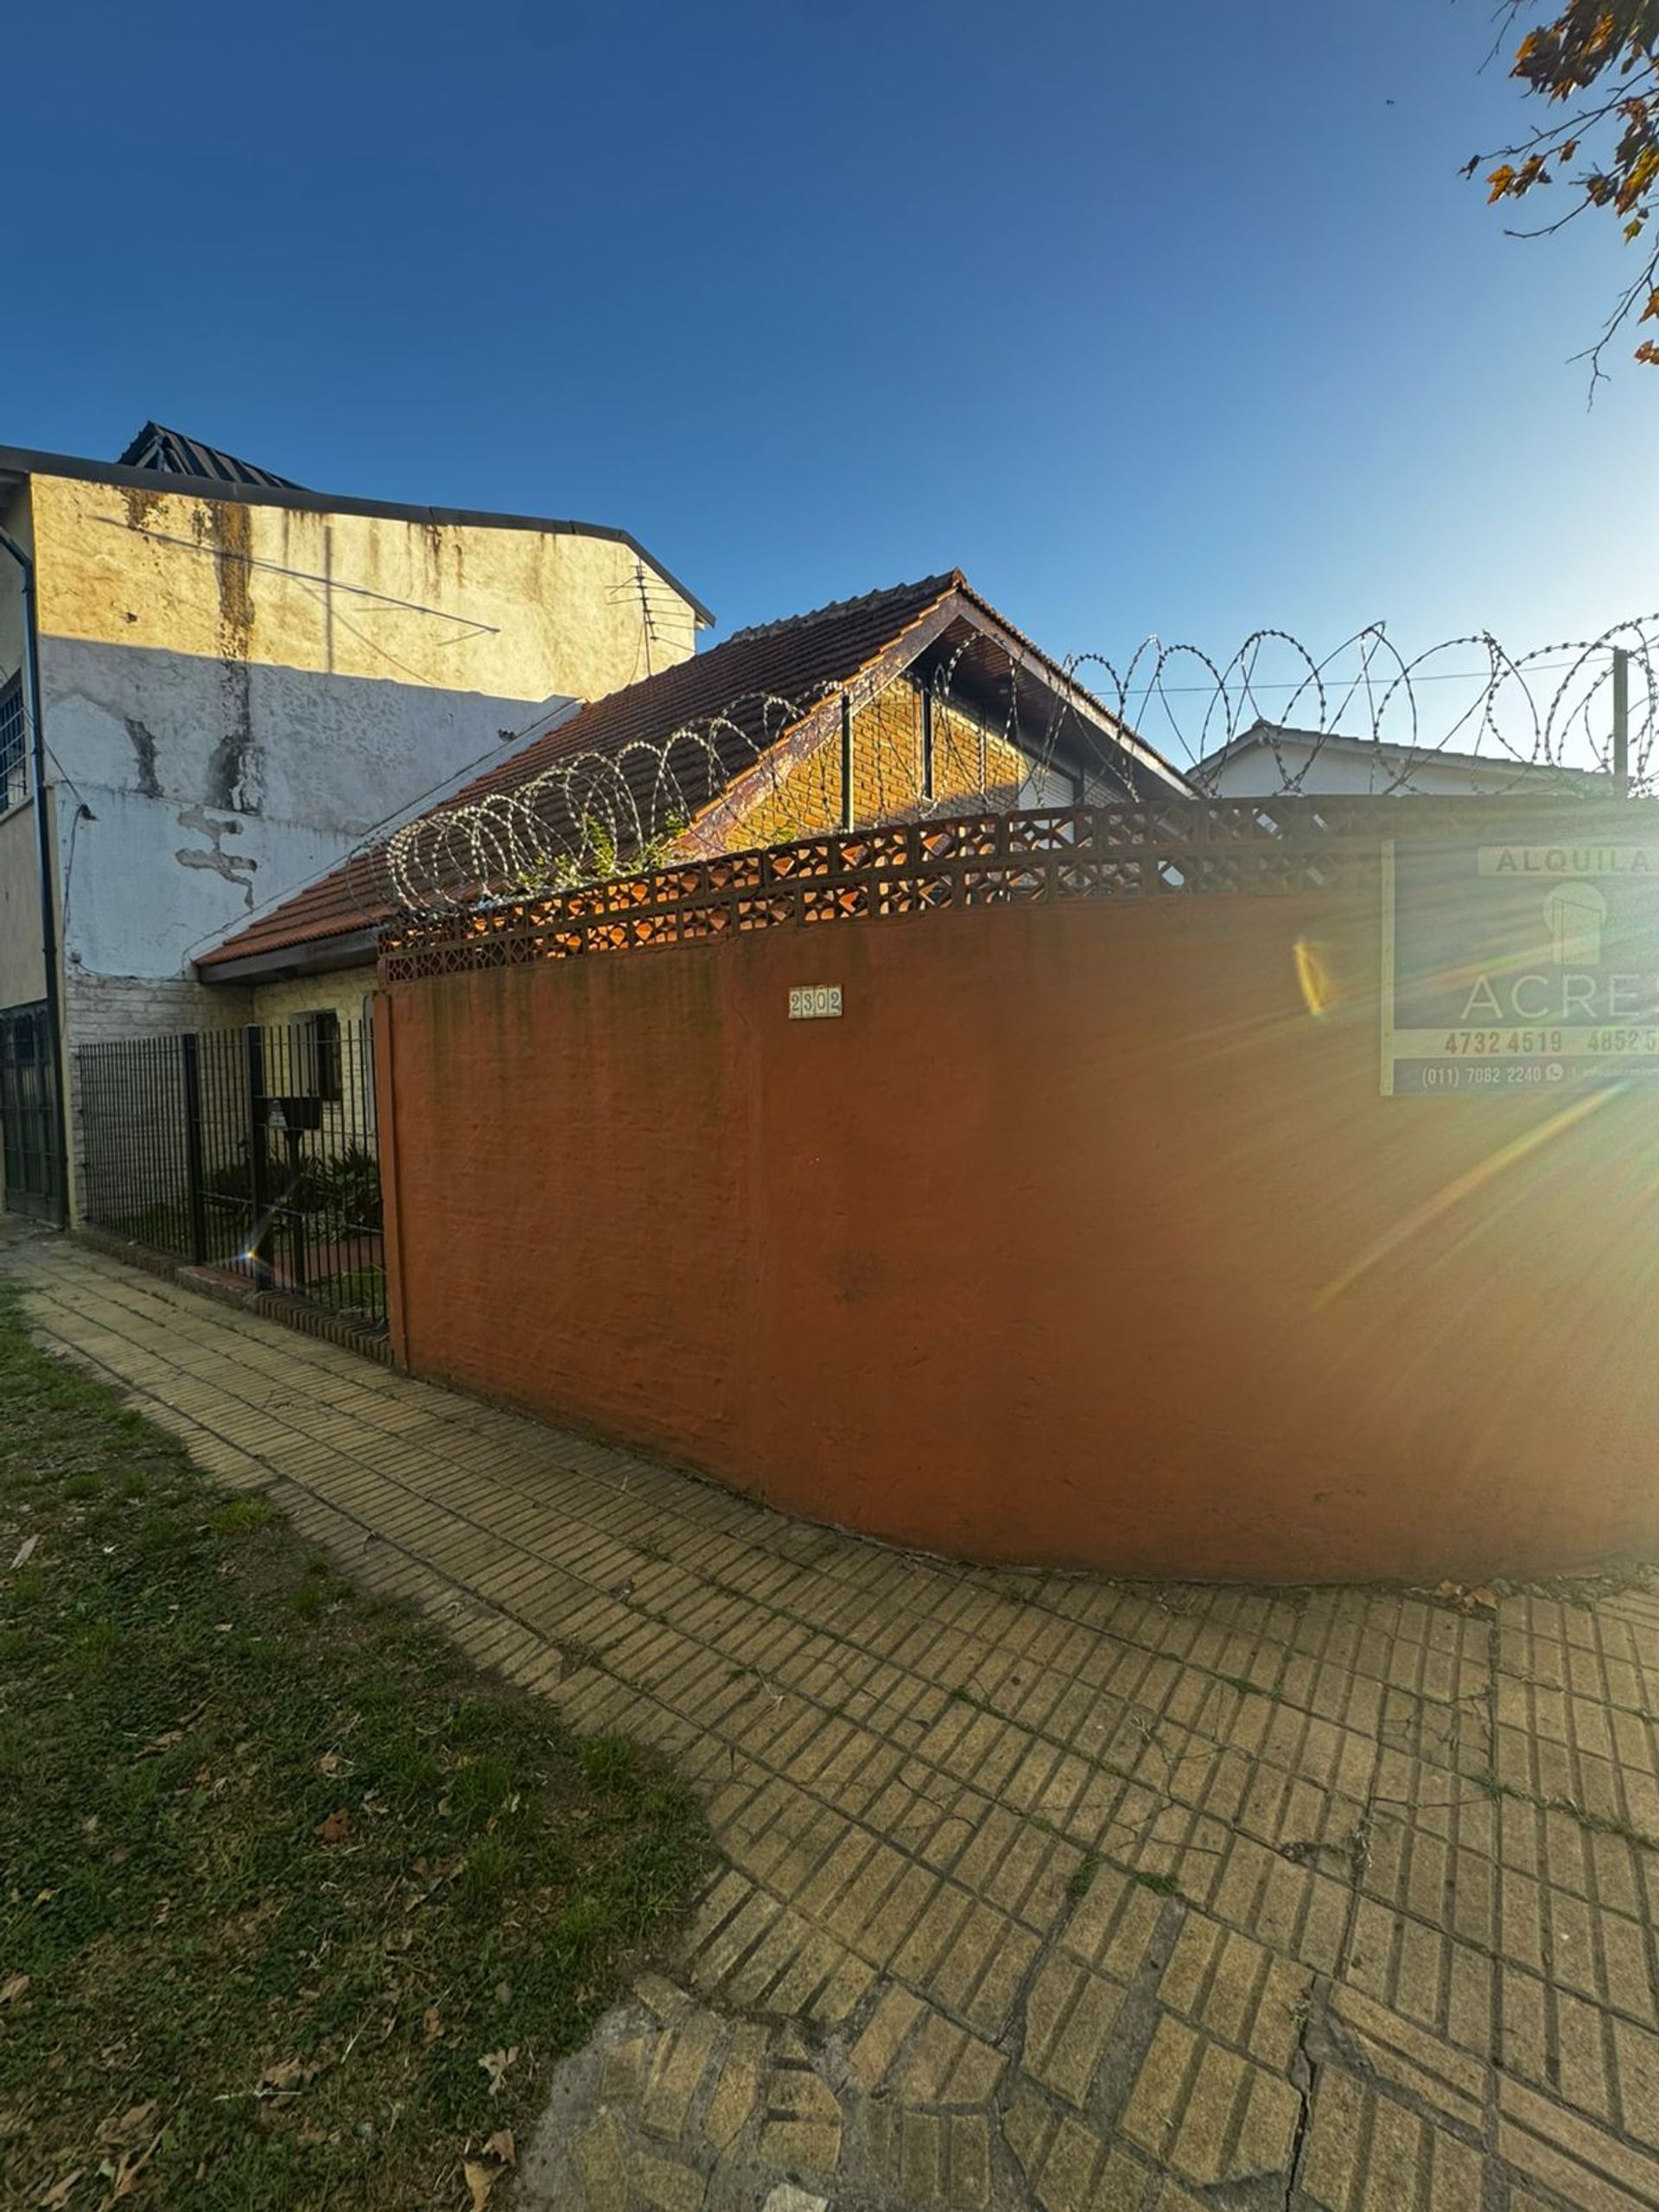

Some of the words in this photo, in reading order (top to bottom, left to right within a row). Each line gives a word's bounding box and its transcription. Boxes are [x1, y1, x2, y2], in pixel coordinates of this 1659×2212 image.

[1496, 849, 1649, 873] ALQUILA
[1444, 1032, 1500, 1054] 4732
[1506, 1031, 1562, 1052] 4519
[1422, 1065, 1459, 1088] (011)
[1466, 1067, 1501, 1084] 7082
[1507, 1066, 1541, 1082] 2240
